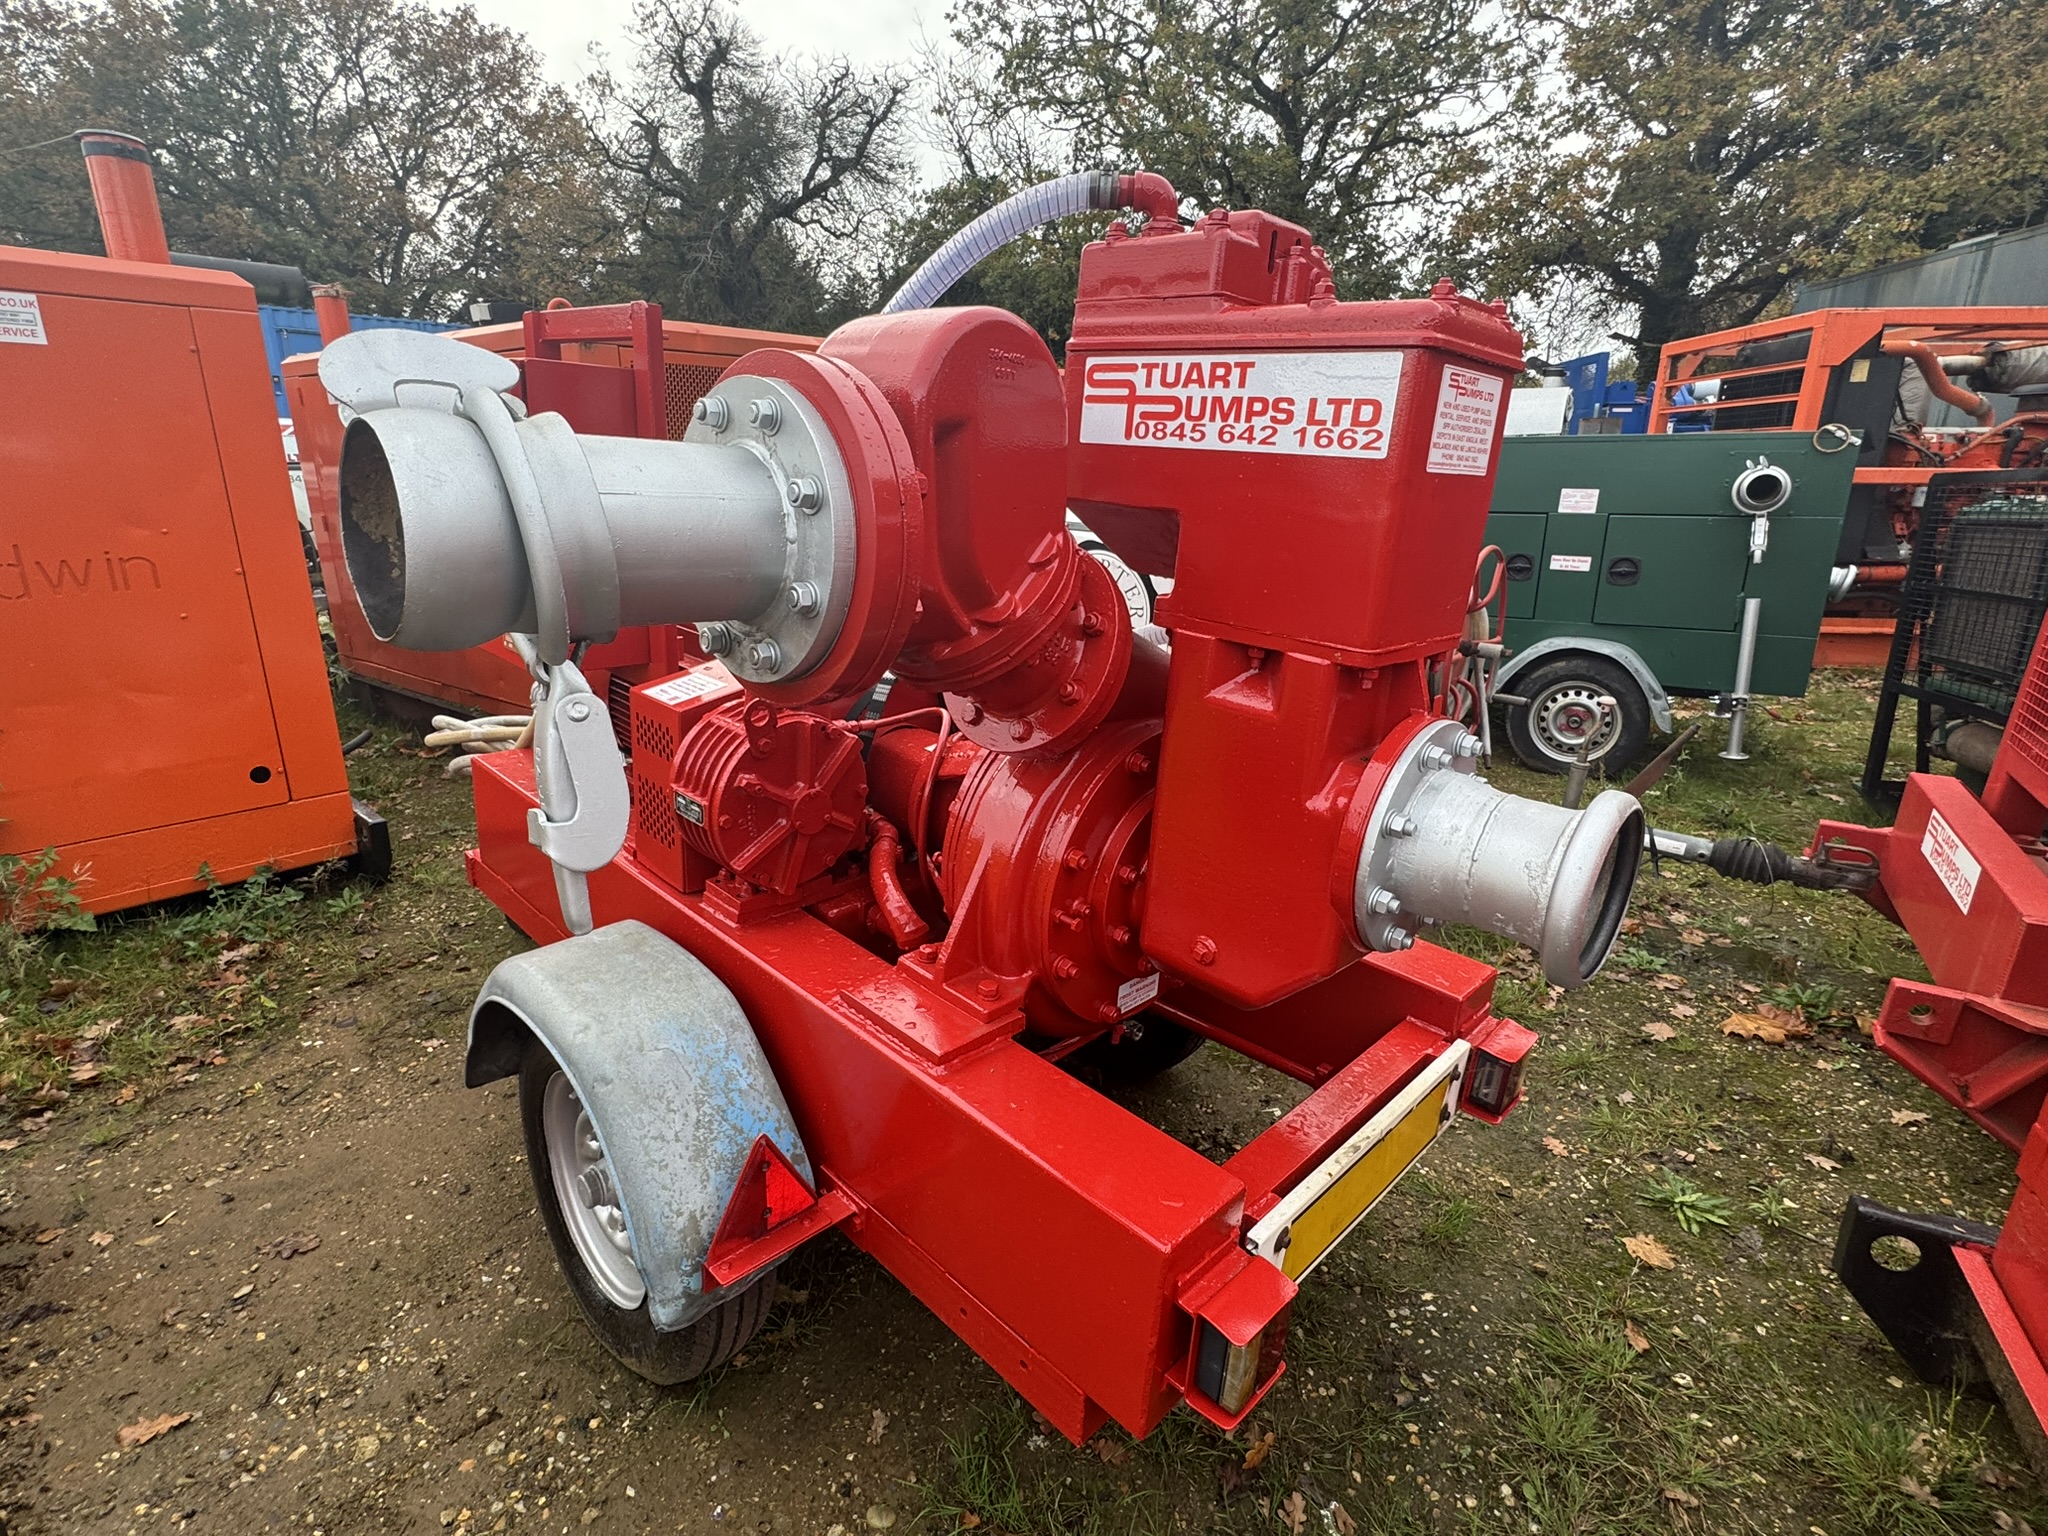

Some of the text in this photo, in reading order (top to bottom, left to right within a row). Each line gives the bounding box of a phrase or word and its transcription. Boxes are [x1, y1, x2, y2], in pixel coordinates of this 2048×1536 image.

[1086, 361, 1255, 391] STUART
[1449, 372, 1480, 387] STUART
[1448, 383, 1495, 402] PUMPS LTD
[1085, 395, 1383, 440] PUMPS LTD
[1133, 421, 1385, 452] 0845 642 1662
[1929, 815, 1959, 856] STUART
[1928, 829, 1972, 897] PUMPS LTD
